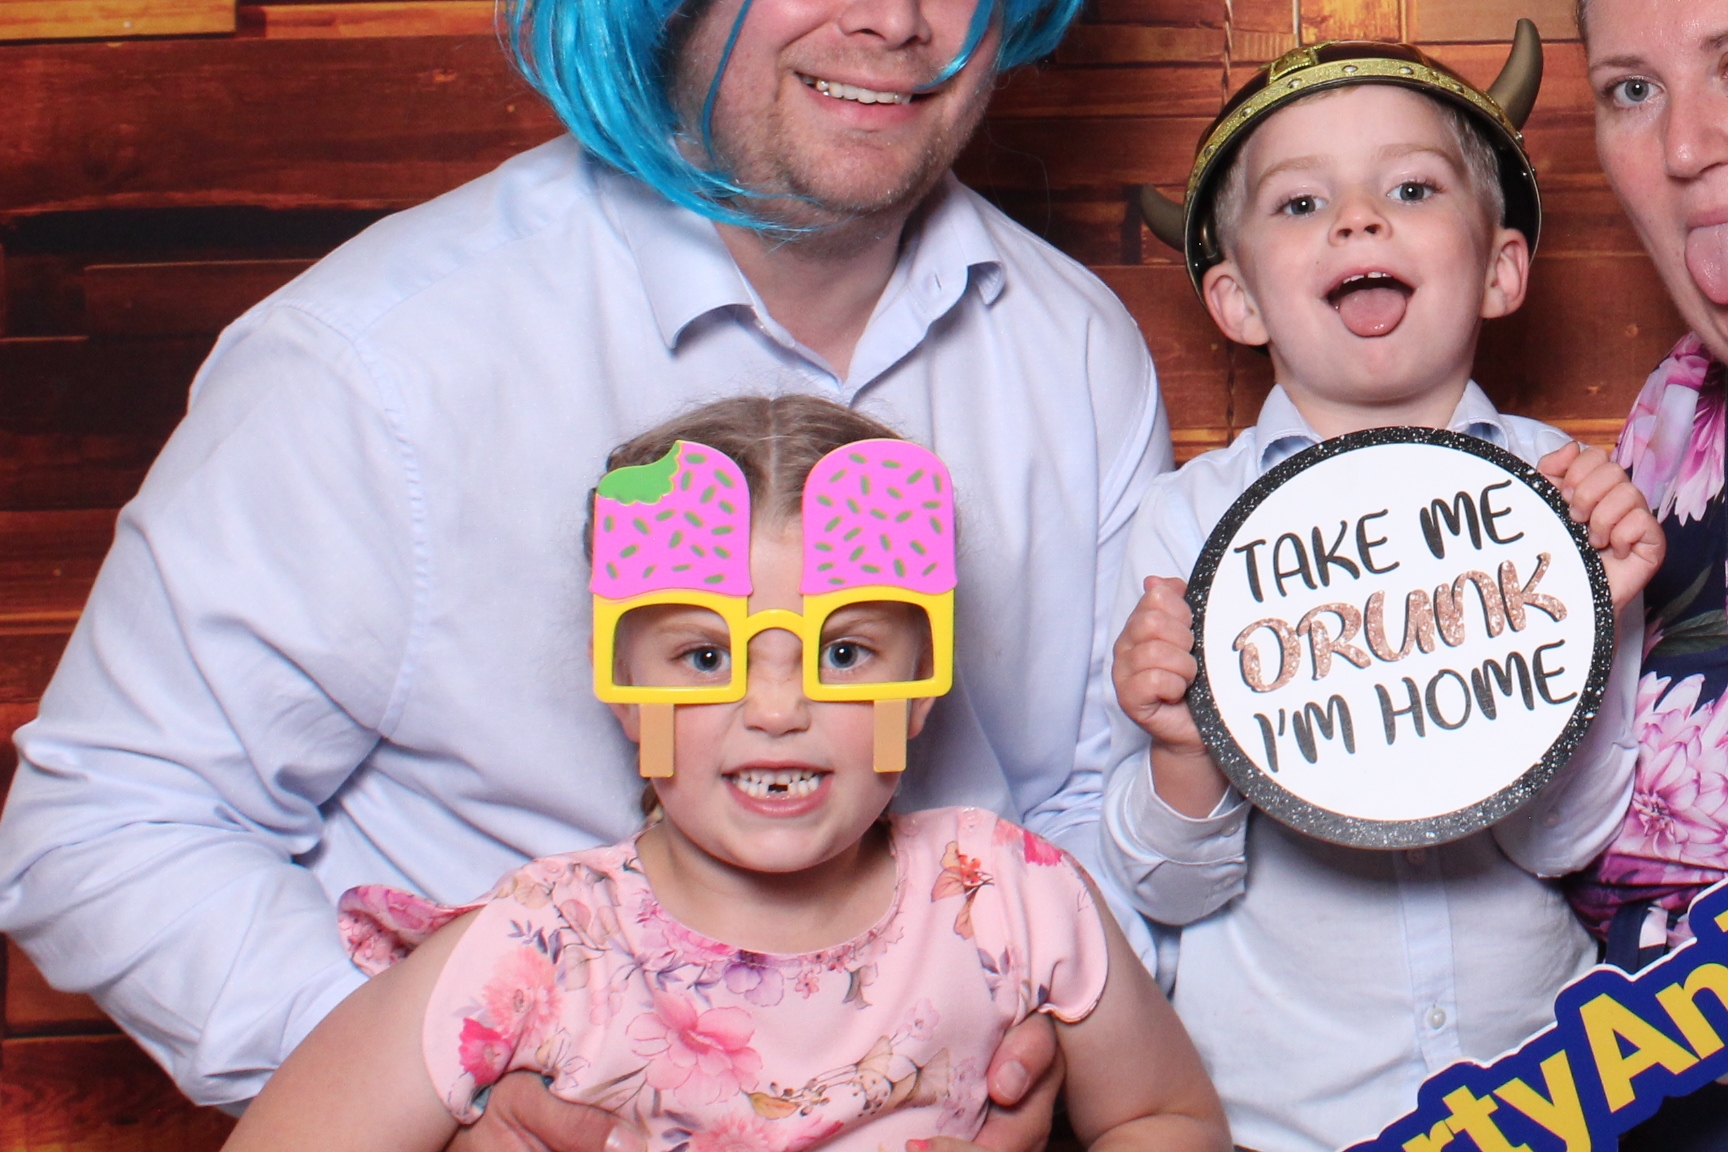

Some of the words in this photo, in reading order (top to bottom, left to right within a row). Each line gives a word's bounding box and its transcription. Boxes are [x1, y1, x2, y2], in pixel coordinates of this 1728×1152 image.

[1233, 508, 1400, 603] TAKE
[1419, 479, 1525, 561] ME
[1231, 551, 1569, 694] DRUNK
[1252, 693, 1357, 774] I'M
[1373, 638, 1579, 747] HOME
